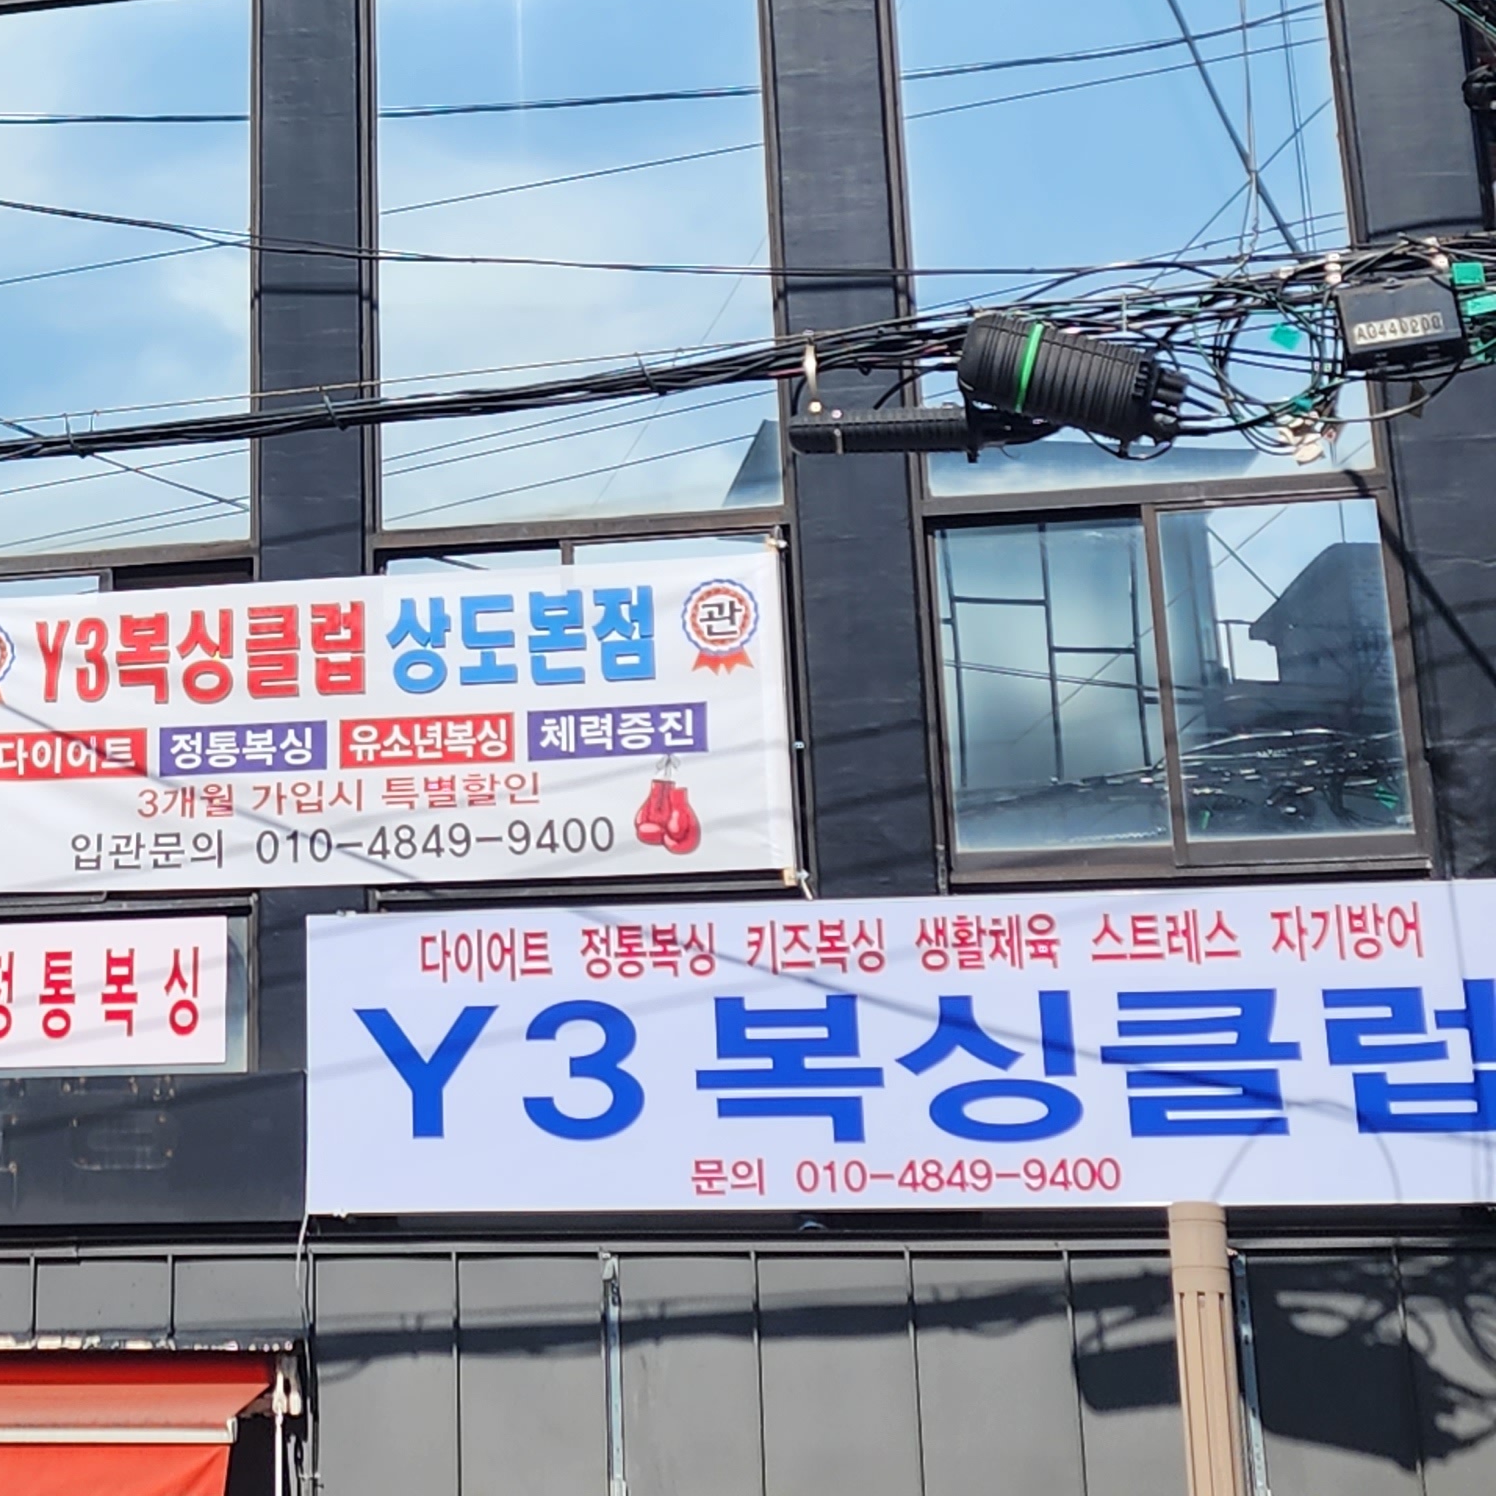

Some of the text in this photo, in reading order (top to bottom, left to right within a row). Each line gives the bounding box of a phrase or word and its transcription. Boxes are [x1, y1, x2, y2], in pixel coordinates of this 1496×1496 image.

[699, 600, 743, 640] 관
[35, 585, 656, 704] Y3복싱클럽 상도본점
[169, 727, 313, 770] 정통복싱
[349, 718, 509, 762] 유소년복싱
[539, 708, 695, 753] 체력증진
[137, 771, 540, 819] 3개월 가입시 특별할인
[70, 816, 614, 871] 입관문의 010-4849-9400
[420, 901, 1424, 982] 다이어트 정통복싱 키즈복싱 생활체육 스트레스 자기방어
[691, 1157, 1122, 1196] 문의 010-4849-9400
